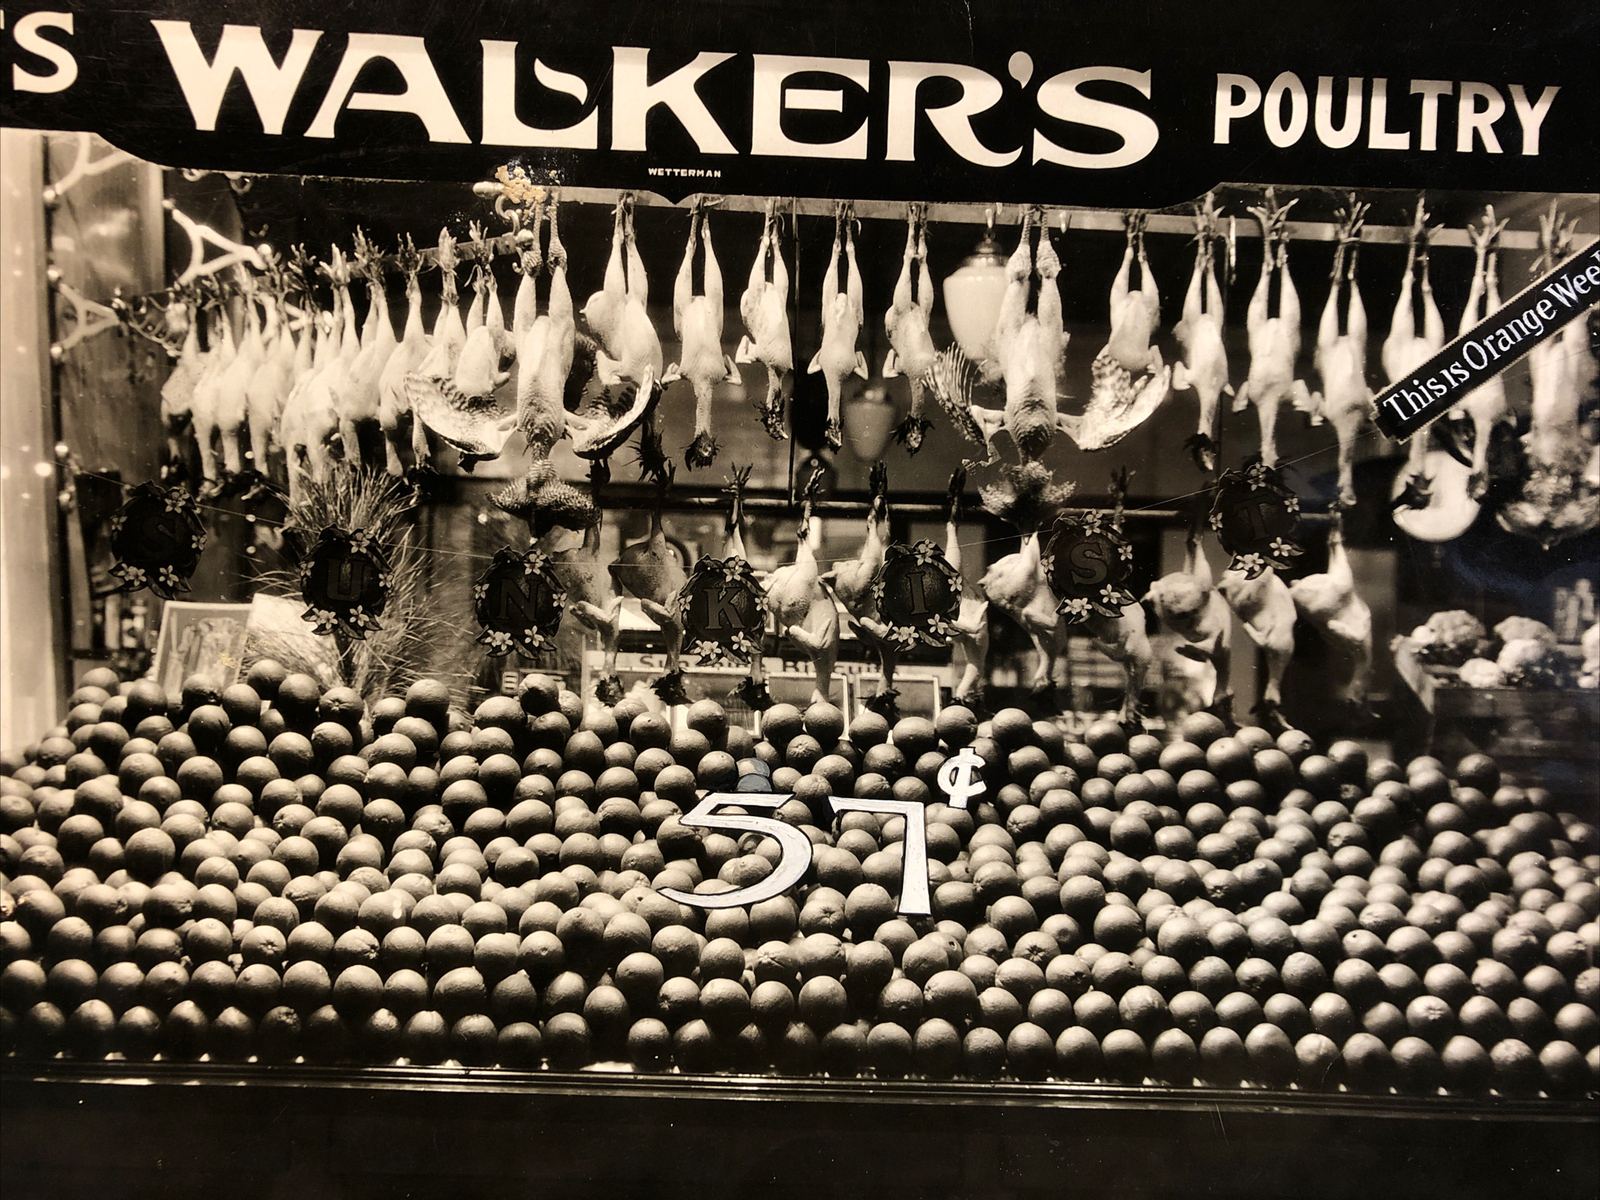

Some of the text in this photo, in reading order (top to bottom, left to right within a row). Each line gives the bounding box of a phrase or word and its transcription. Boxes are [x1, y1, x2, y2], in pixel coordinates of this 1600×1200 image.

[0, 9, 1562, 169] S WALKER'S POULTRY
[648, 167, 722, 178] WETTERMAN
[1383, 378, 1448, 421] This
[1462, 298, 1557, 371] Orange
